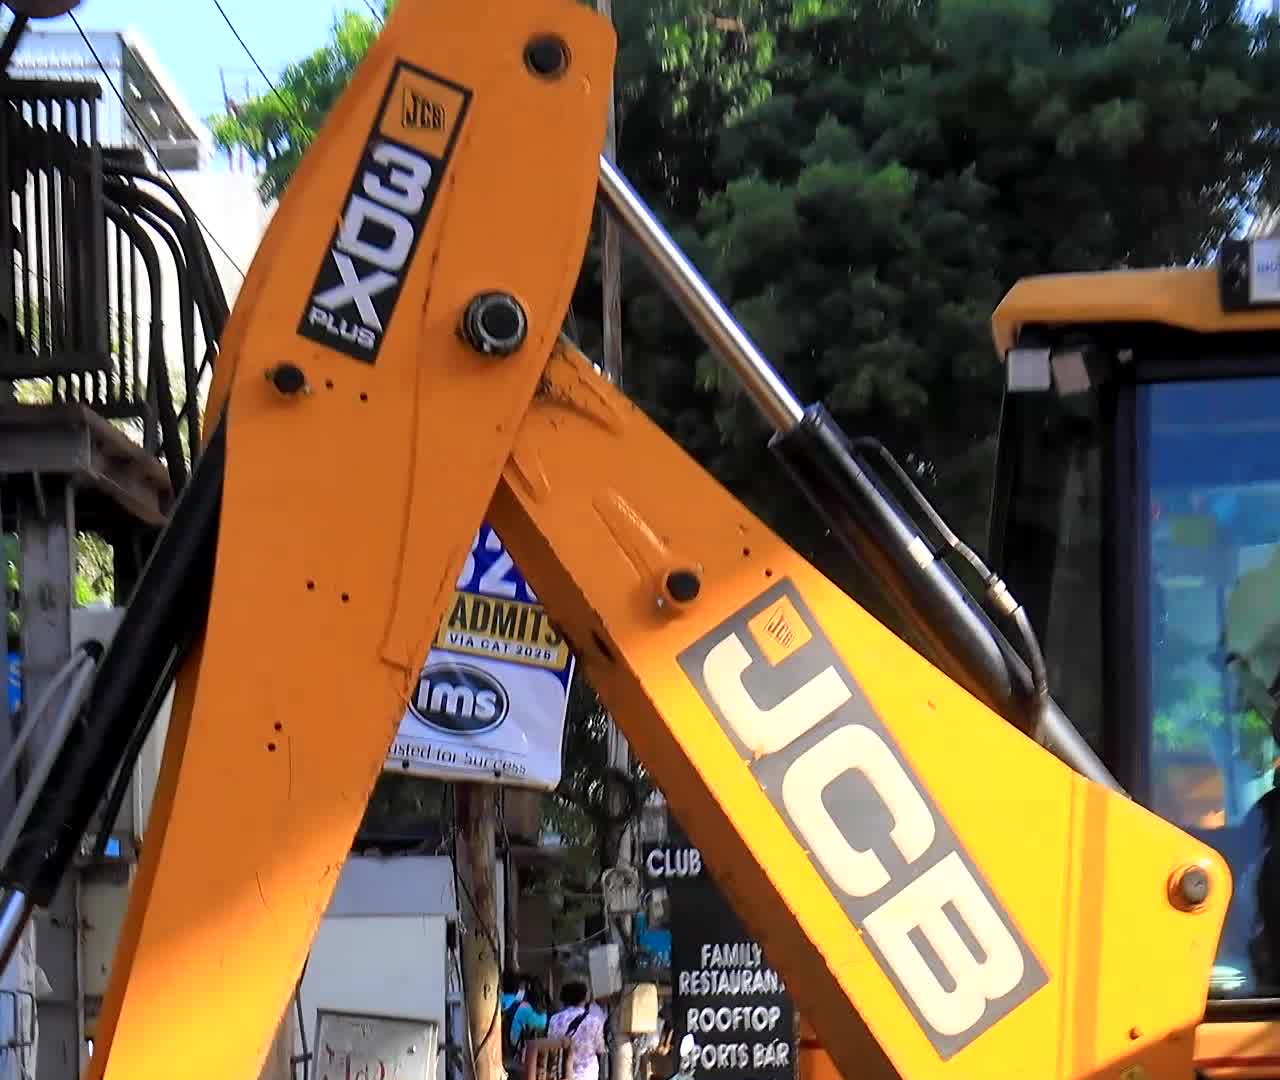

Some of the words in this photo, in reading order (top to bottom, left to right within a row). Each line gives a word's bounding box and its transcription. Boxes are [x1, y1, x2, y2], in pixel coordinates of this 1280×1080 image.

[401, 89, 446, 128] JCB
[311, 142, 433, 332] 3DX
[308, 307, 377, 348] PLUS
[450, 633, 474, 647] VIA
[481, 639, 508, 653] CAT
[437, 749, 456, 763] for
[701, 632, 1025, 1036] JCB
[646, 848, 701, 877] CLUB
[701, 943, 762, 967] FAMILY
[679, 970, 786, 995] RESTAURAN
[686, 1006, 781, 1032] ROOFTOP
